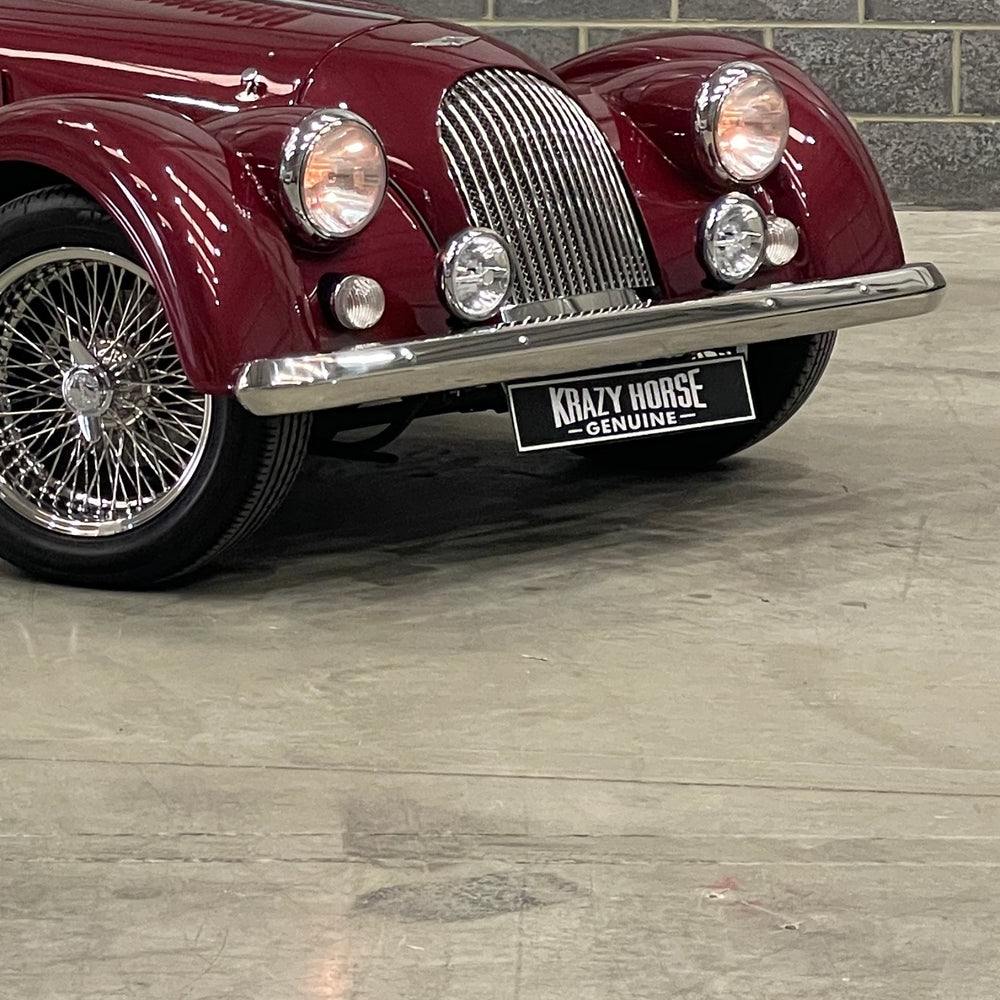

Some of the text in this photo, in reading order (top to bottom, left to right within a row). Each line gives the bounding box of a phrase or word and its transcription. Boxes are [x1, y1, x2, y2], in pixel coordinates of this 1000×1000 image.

[549, 368, 707, 429] KRAZY HORSE
[586, 411, 677, 436] GENUINE
